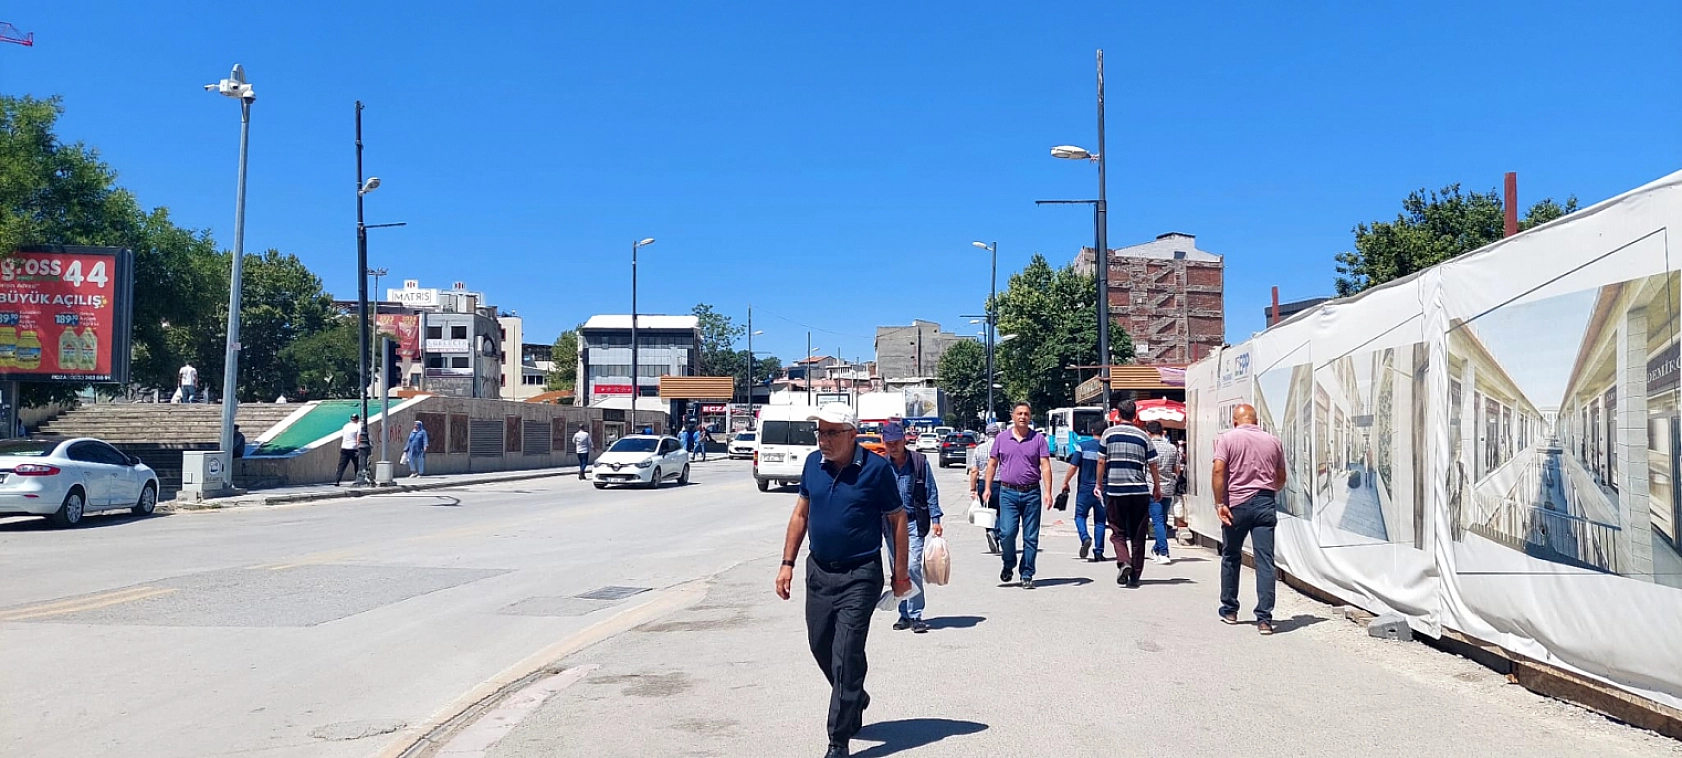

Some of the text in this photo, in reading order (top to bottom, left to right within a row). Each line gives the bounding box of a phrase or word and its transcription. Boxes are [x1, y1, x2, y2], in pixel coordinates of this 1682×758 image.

[63, 260, 108, 287] 44
[0, 290, 102, 309] BÜYÜK AÇILIŞ
